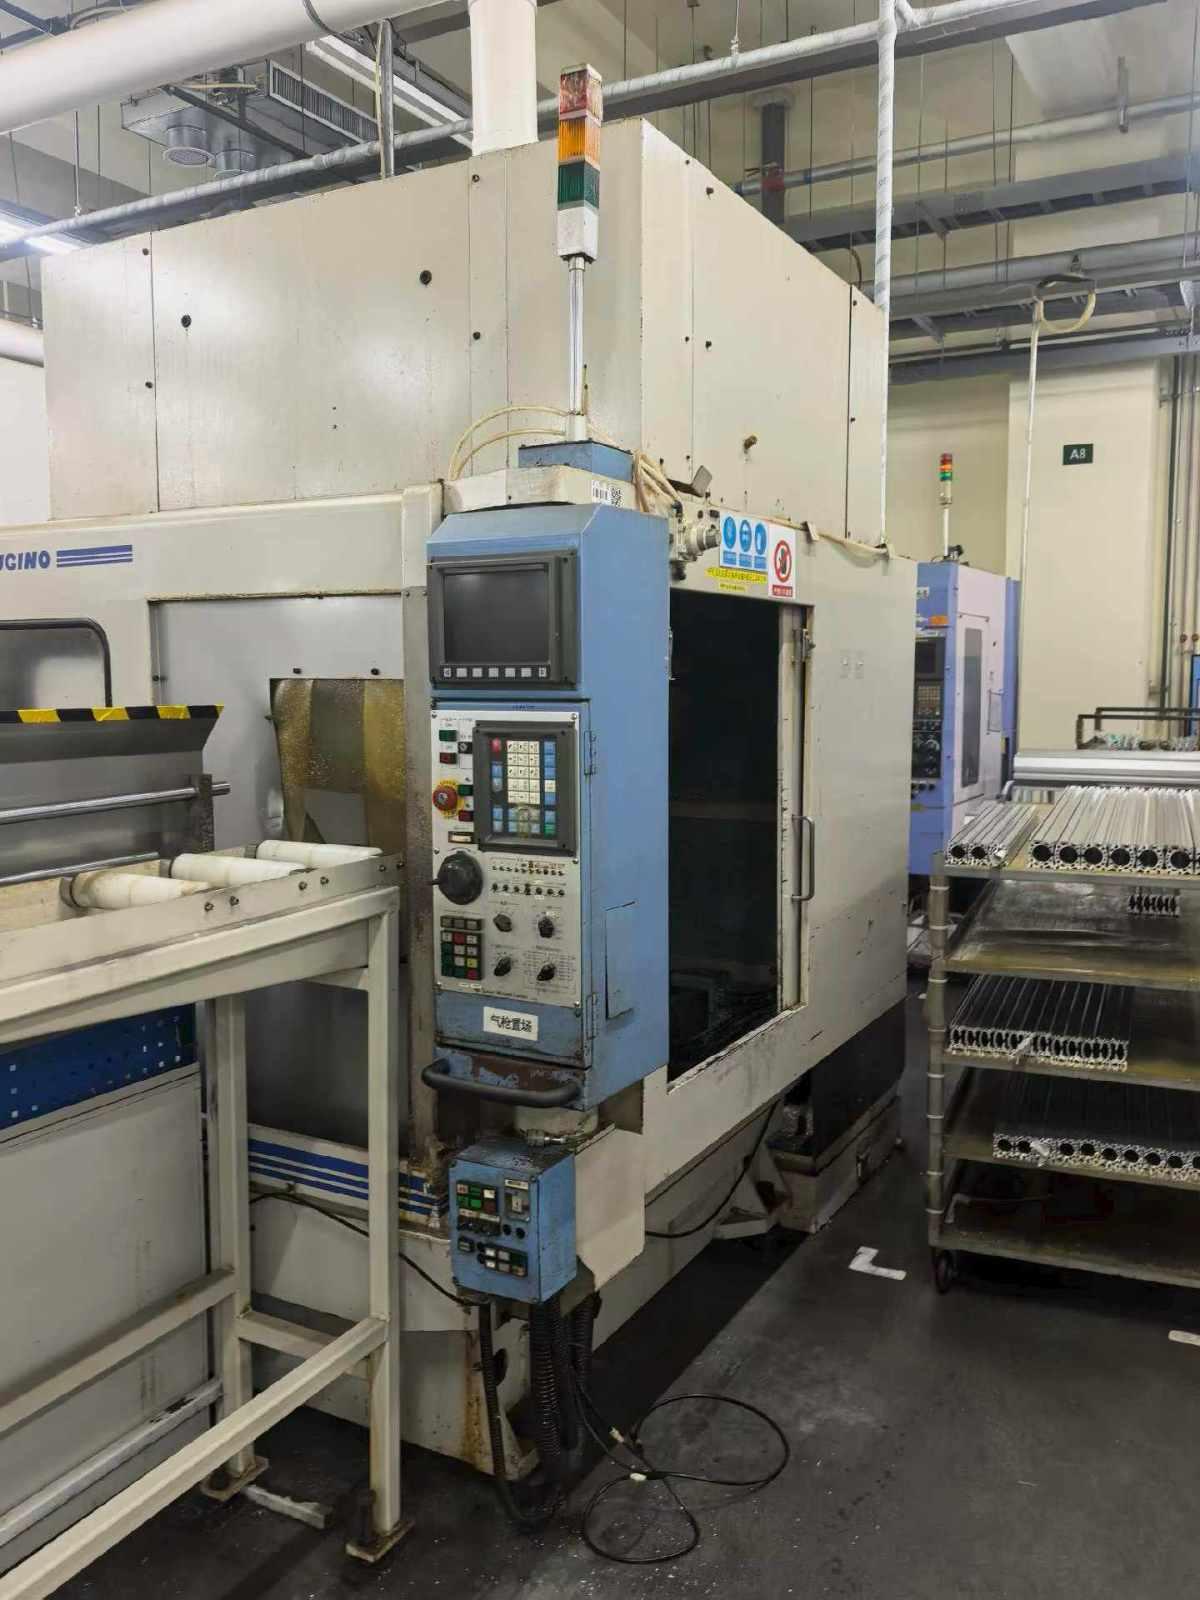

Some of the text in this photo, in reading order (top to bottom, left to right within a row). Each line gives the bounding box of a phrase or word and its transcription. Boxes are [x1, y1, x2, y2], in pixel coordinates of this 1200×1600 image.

[1069, 447, 1086, 460] A8
[490, 1013, 532, 1033] 气枪置场
